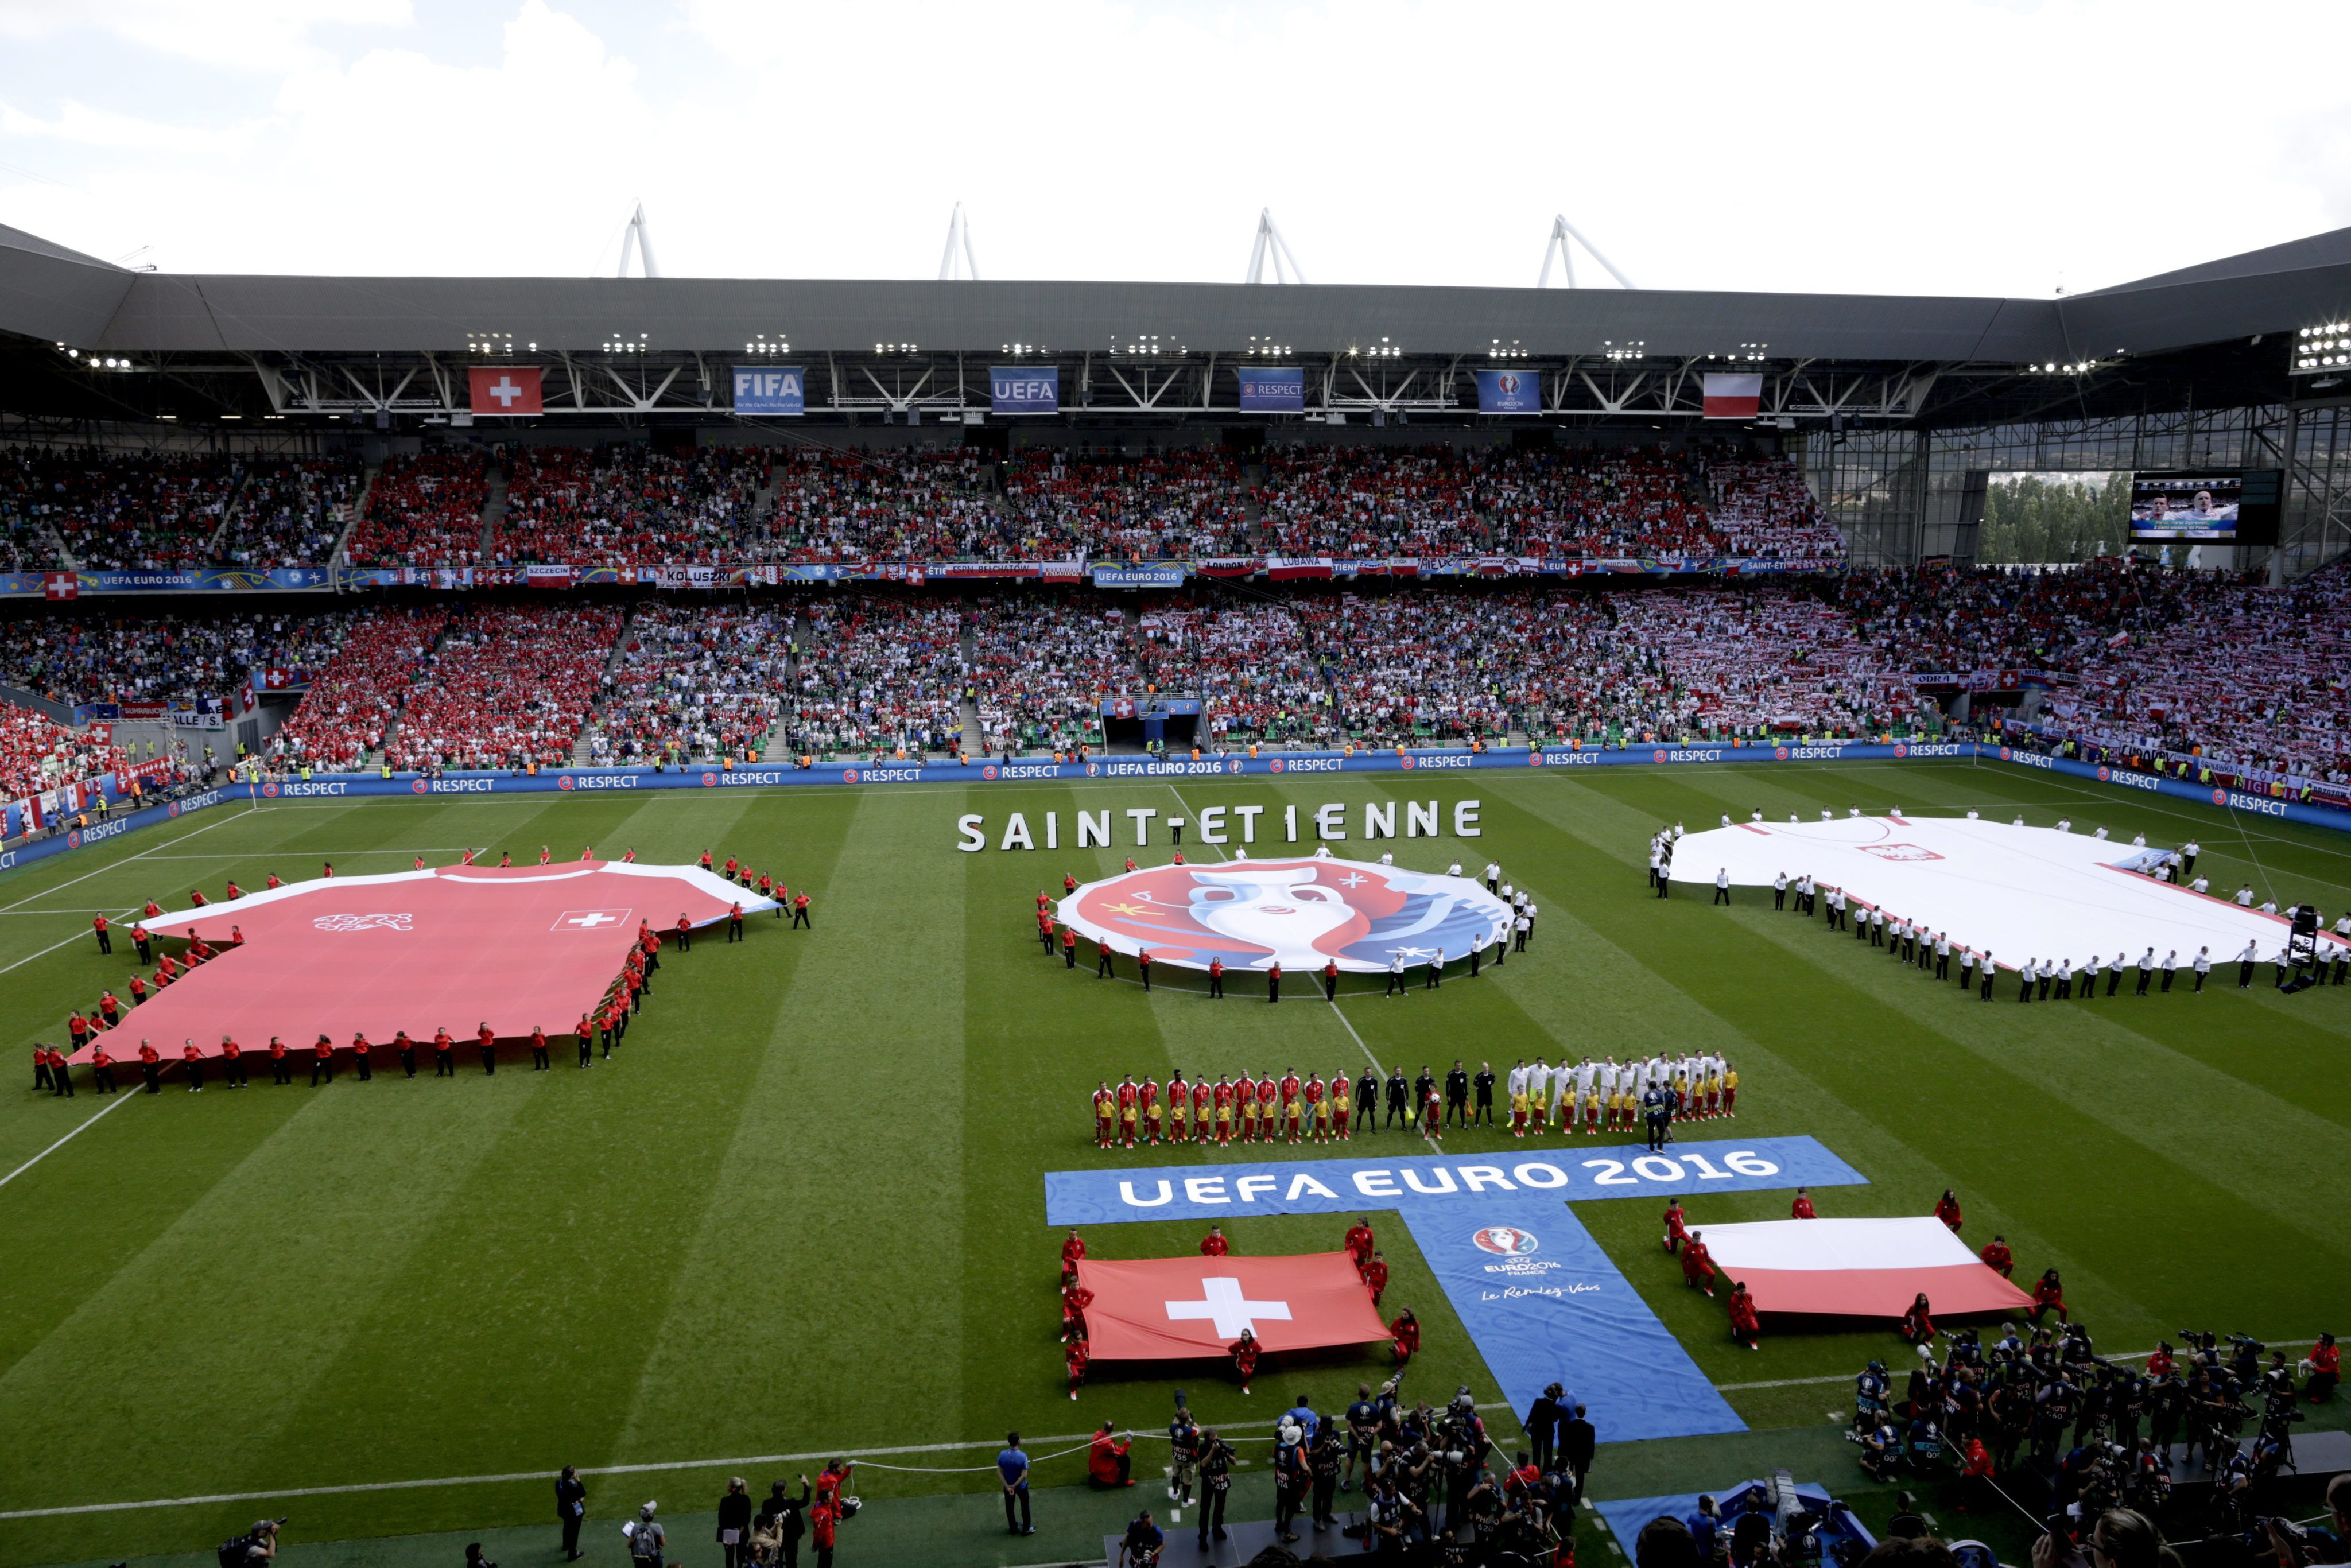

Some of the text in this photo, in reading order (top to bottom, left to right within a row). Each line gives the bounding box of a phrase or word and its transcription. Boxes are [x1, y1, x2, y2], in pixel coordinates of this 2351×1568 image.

[735, 374, 801, 396] FIFA
[994, 382, 1054, 399] UEFA
[1258, 385, 1302, 394] RESPECT
[1206, 561, 1244, 570] LONDON
[1282, 557, 1321, 566] LUBAWA
[529, 566, 568, 575] SZCZECIN
[953, 565, 973, 574] ESPN
[103, 575, 192, 585] UEFA EURO 2016
[667, 571, 730, 582] KOLUSZKI
[1099, 573, 1177, 581] UEFA EURO 2016
[125, 707, 168, 715] SUHR/BUCHS
[1670, 749, 1721, 762] RESPECT
[1791, 747, 1841, 759] RESPECT
[1910, 744, 1960, 756] RESPECT
[1288, 758, 1344, 771] RESPECT
[1419, 755, 1473, 769] RESPECT
[1546, 752, 1599, 765] RESPECT
[2012, 750, 2054, 769] RESPECT
[1002, 766, 1060, 778] RESPECT
[1107, 761, 1222, 775] UEFA EURO 2016
[579, 775, 639, 789] RESPECT
[721, 771, 781, 785] RESPECT
[863, 769, 922, 782] RESPECT
[2112, 770, 2160, 790] RESPECT
[284, 782, 347, 796] RESPECT
[433, 778, 494, 792] RESPECT
[181, 790, 219, 813] RESPECT
[2229, 793, 2288, 817] RESPECT
[83, 818, 127, 843] RESPECT
[1119, 1150, 1780, 1208] UEFA EURO 2016
[1481, 1291, 1500, 1301] Le
[1858, 1405, 1872, 1415] 006
